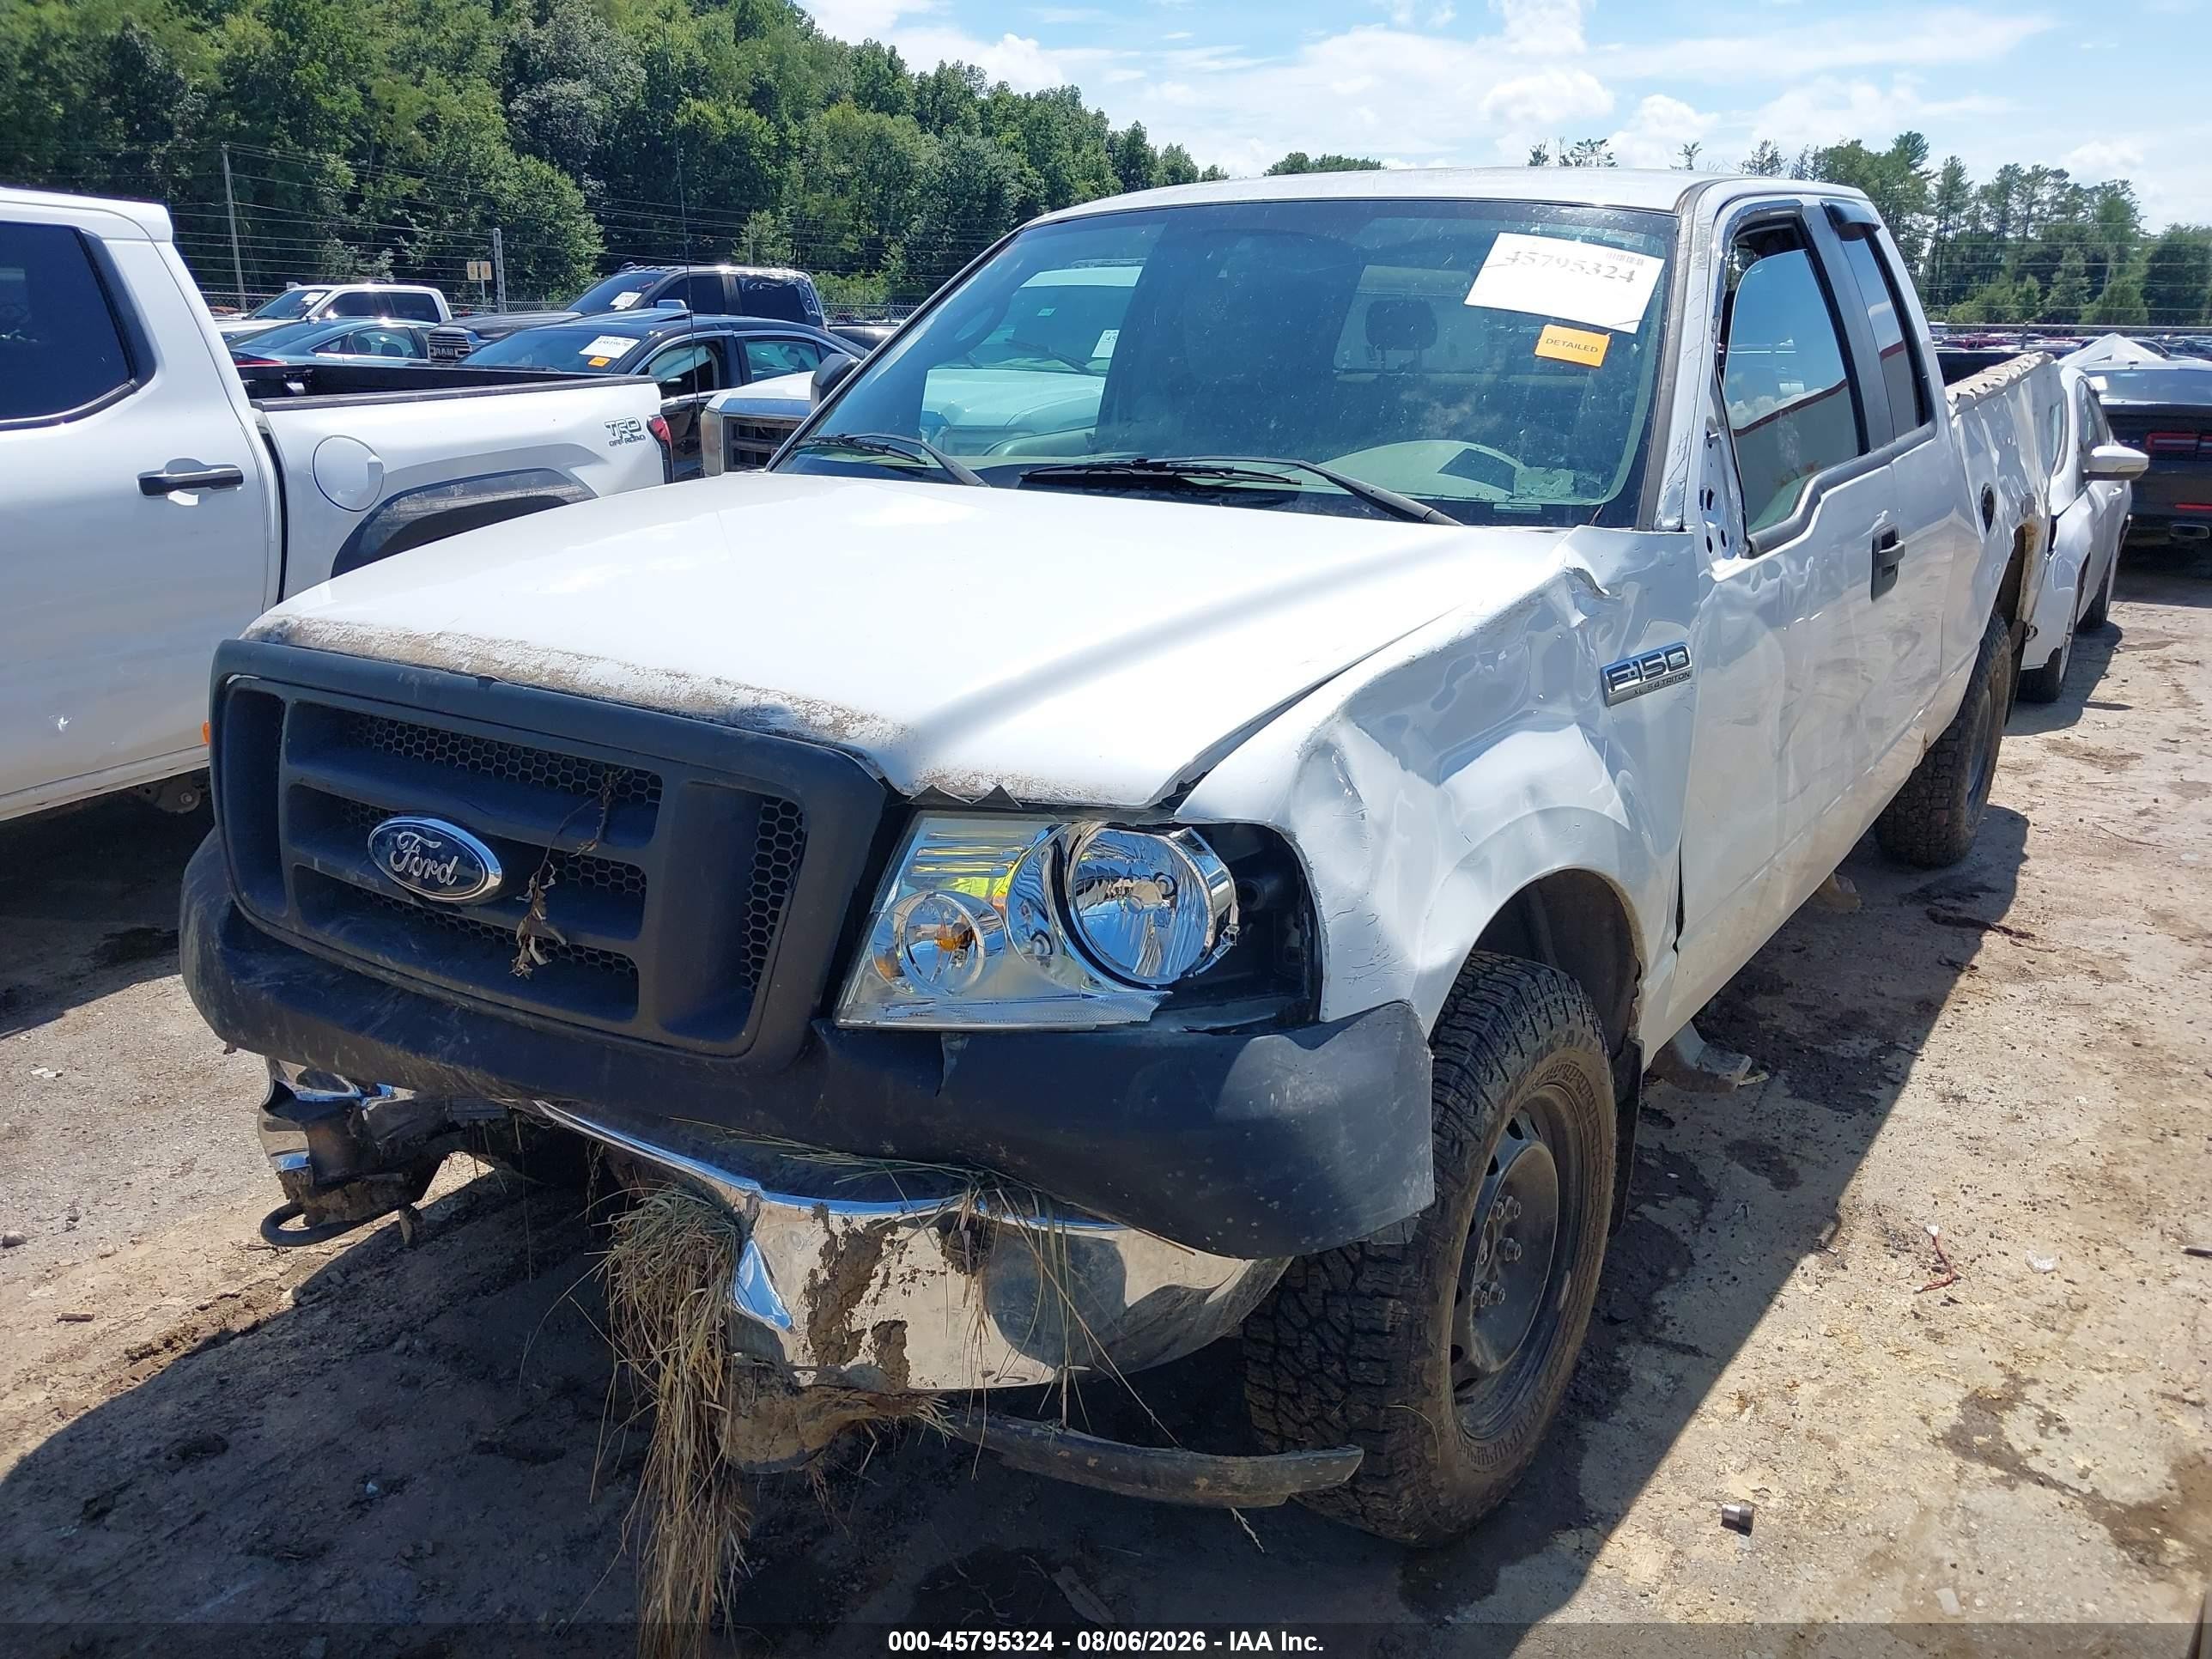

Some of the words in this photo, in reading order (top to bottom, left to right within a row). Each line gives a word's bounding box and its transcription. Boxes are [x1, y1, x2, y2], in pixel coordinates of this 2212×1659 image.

[1505, 251, 1636, 283] 45795324
[1546, 337, 1599, 353] DETAILED
[604, 417, 642, 439] TRD
[1661, 671, 1691, 686] TRITON
[390, 831, 459, 886] Ford
